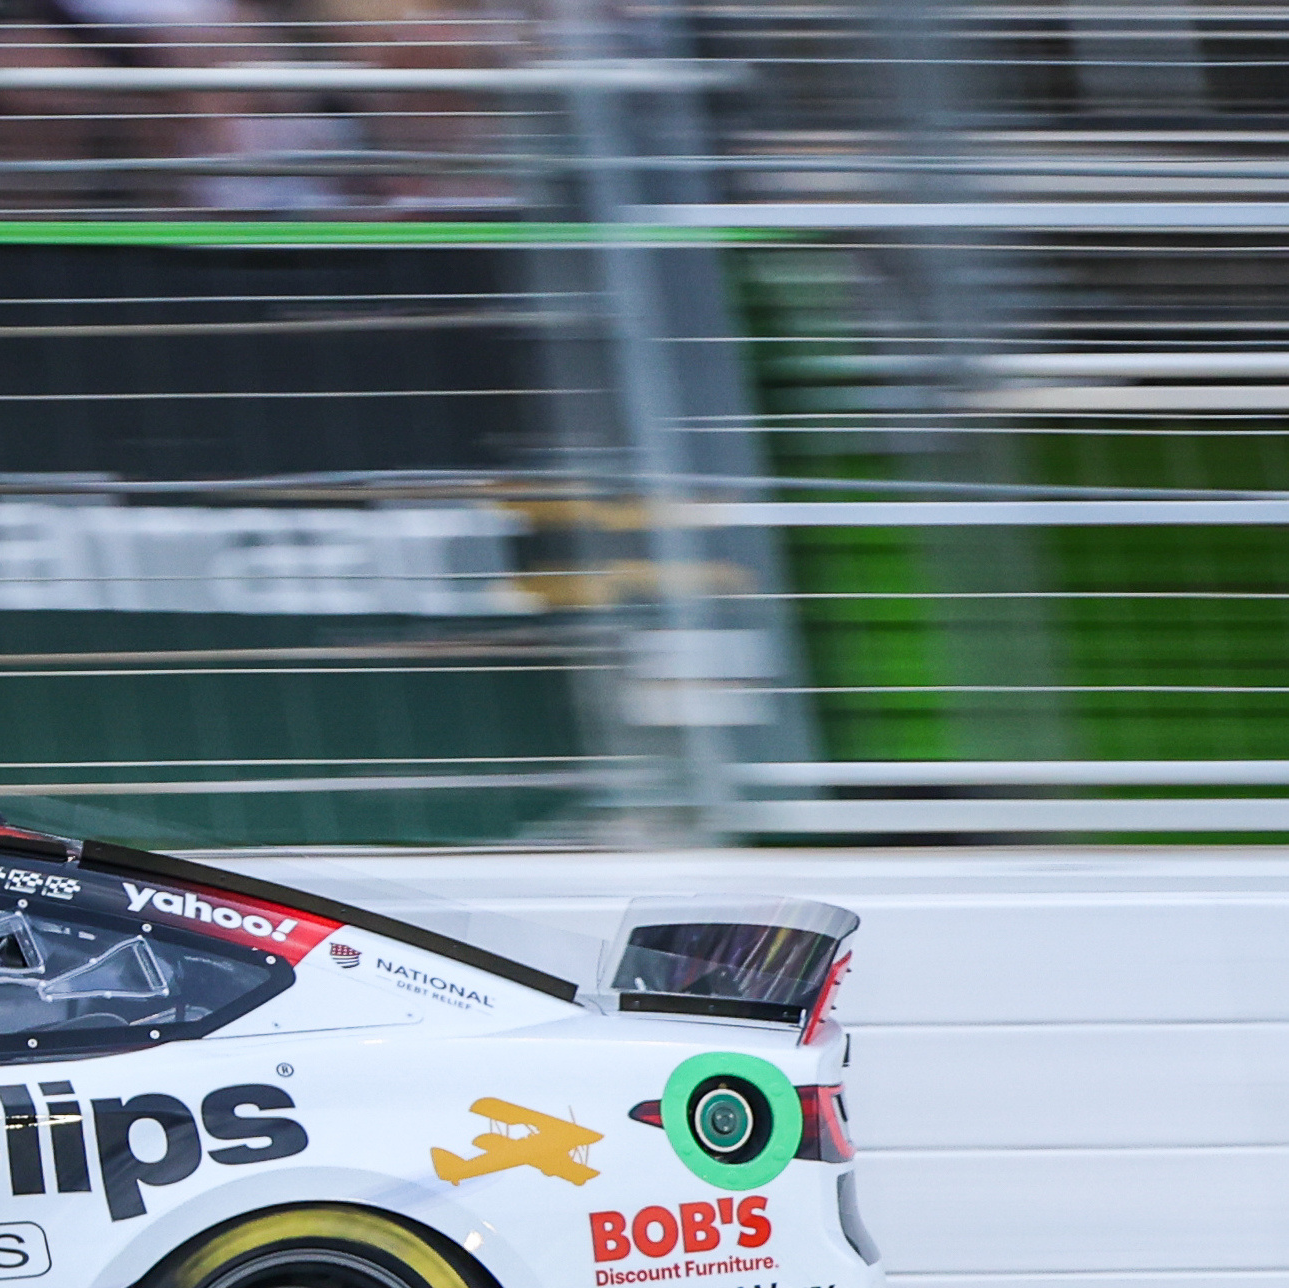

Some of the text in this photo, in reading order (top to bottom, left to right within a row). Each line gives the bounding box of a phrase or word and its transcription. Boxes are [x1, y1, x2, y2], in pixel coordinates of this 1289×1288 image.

[122, 882, 298, 942] yahoo!
[376, 958, 494, 1008] NATIONAL
[396, 980, 472, 1010] DEBT RELIEF
[589, 1195, 772, 1263] BOB'S
[595, 1261, 681, 1287] Discount
